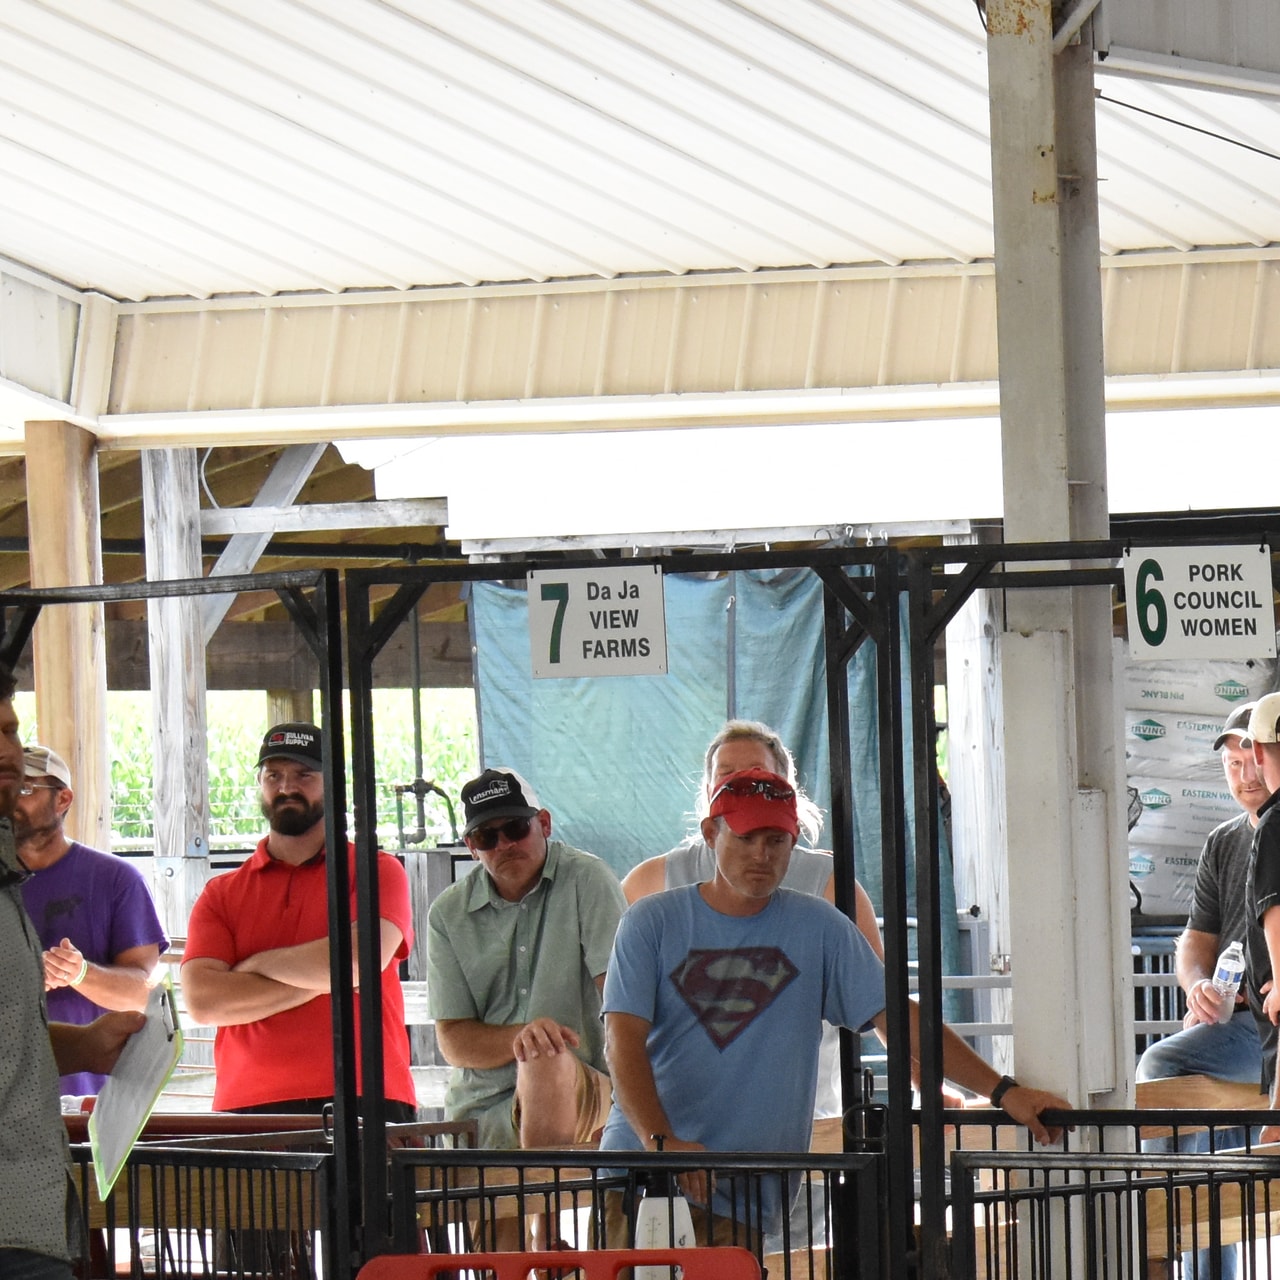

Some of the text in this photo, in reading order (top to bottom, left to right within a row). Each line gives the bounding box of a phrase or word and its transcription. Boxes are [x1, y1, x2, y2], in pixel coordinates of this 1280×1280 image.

[1188, 563, 1244, 582] PORK
[586, 580, 640, 601] Da Ja
[1173, 590, 1263, 610] COUNCIL
[1135, 558, 1168, 647] 6
[540, 582, 569, 664] 7
[589, 609, 640, 630] VIEW
[1180, 618, 1257, 637] WOMEN
[582, 637, 651, 659] FARMS
[1131, 725, 1167, 735] IRVING
[1176, 721, 1214, 731] EASTERN
[285, 731, 314, 742] SULLIVAN
[285, 739, 309, 747] SUPPLY
[1181, 788, 1218, 800] EASTERN
[1164, 856, 1199, 867] EASTERN
